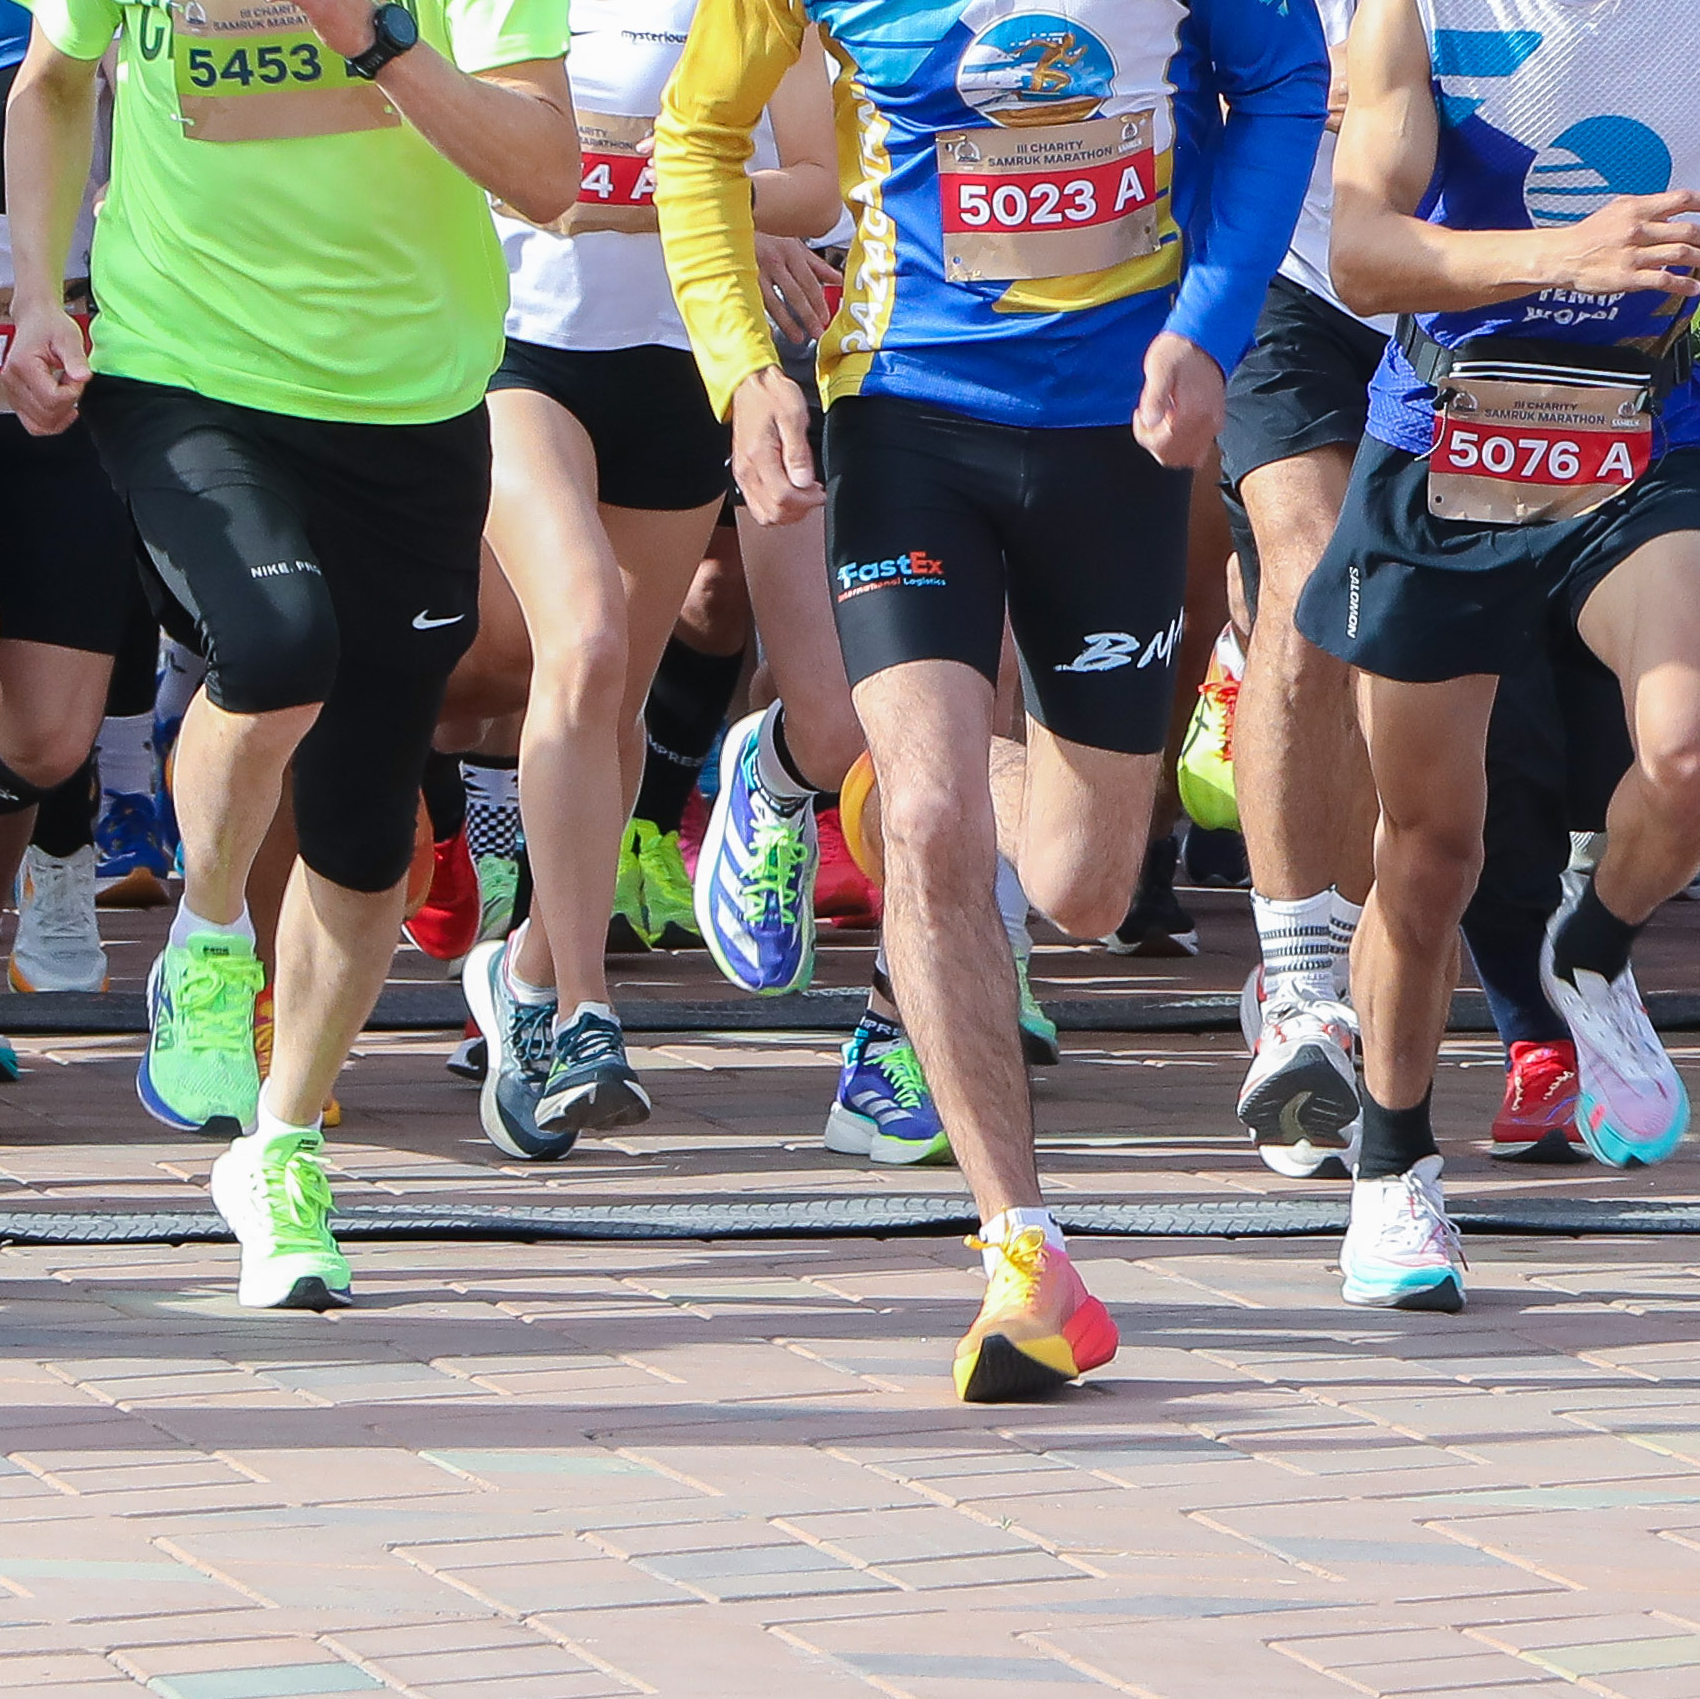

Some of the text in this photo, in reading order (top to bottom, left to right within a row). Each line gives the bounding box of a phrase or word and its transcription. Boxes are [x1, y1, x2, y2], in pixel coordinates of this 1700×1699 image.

[213, 18, 265, 31] SAMRUK
[189, 43, 322, 87] 5453
[988, 147, 1112, 167] SAMRUK MARATHON
[1016, 140, 1083, 154] III CHARITY
[579, 162, 614, 199] 4
[959, 165, 1146, 226] 5023 A
[1485, 408, 1605, 424] SAMRUK MARATHON
[1528, 401, 1578, 411] CHARITY
[1449, 430, 1634, 480] 5076 A
[251, 562, 290, 578] NIKE
[837, 550, 943, 590] FastEx
[1347, 566, 1361, 639] SALOMON
